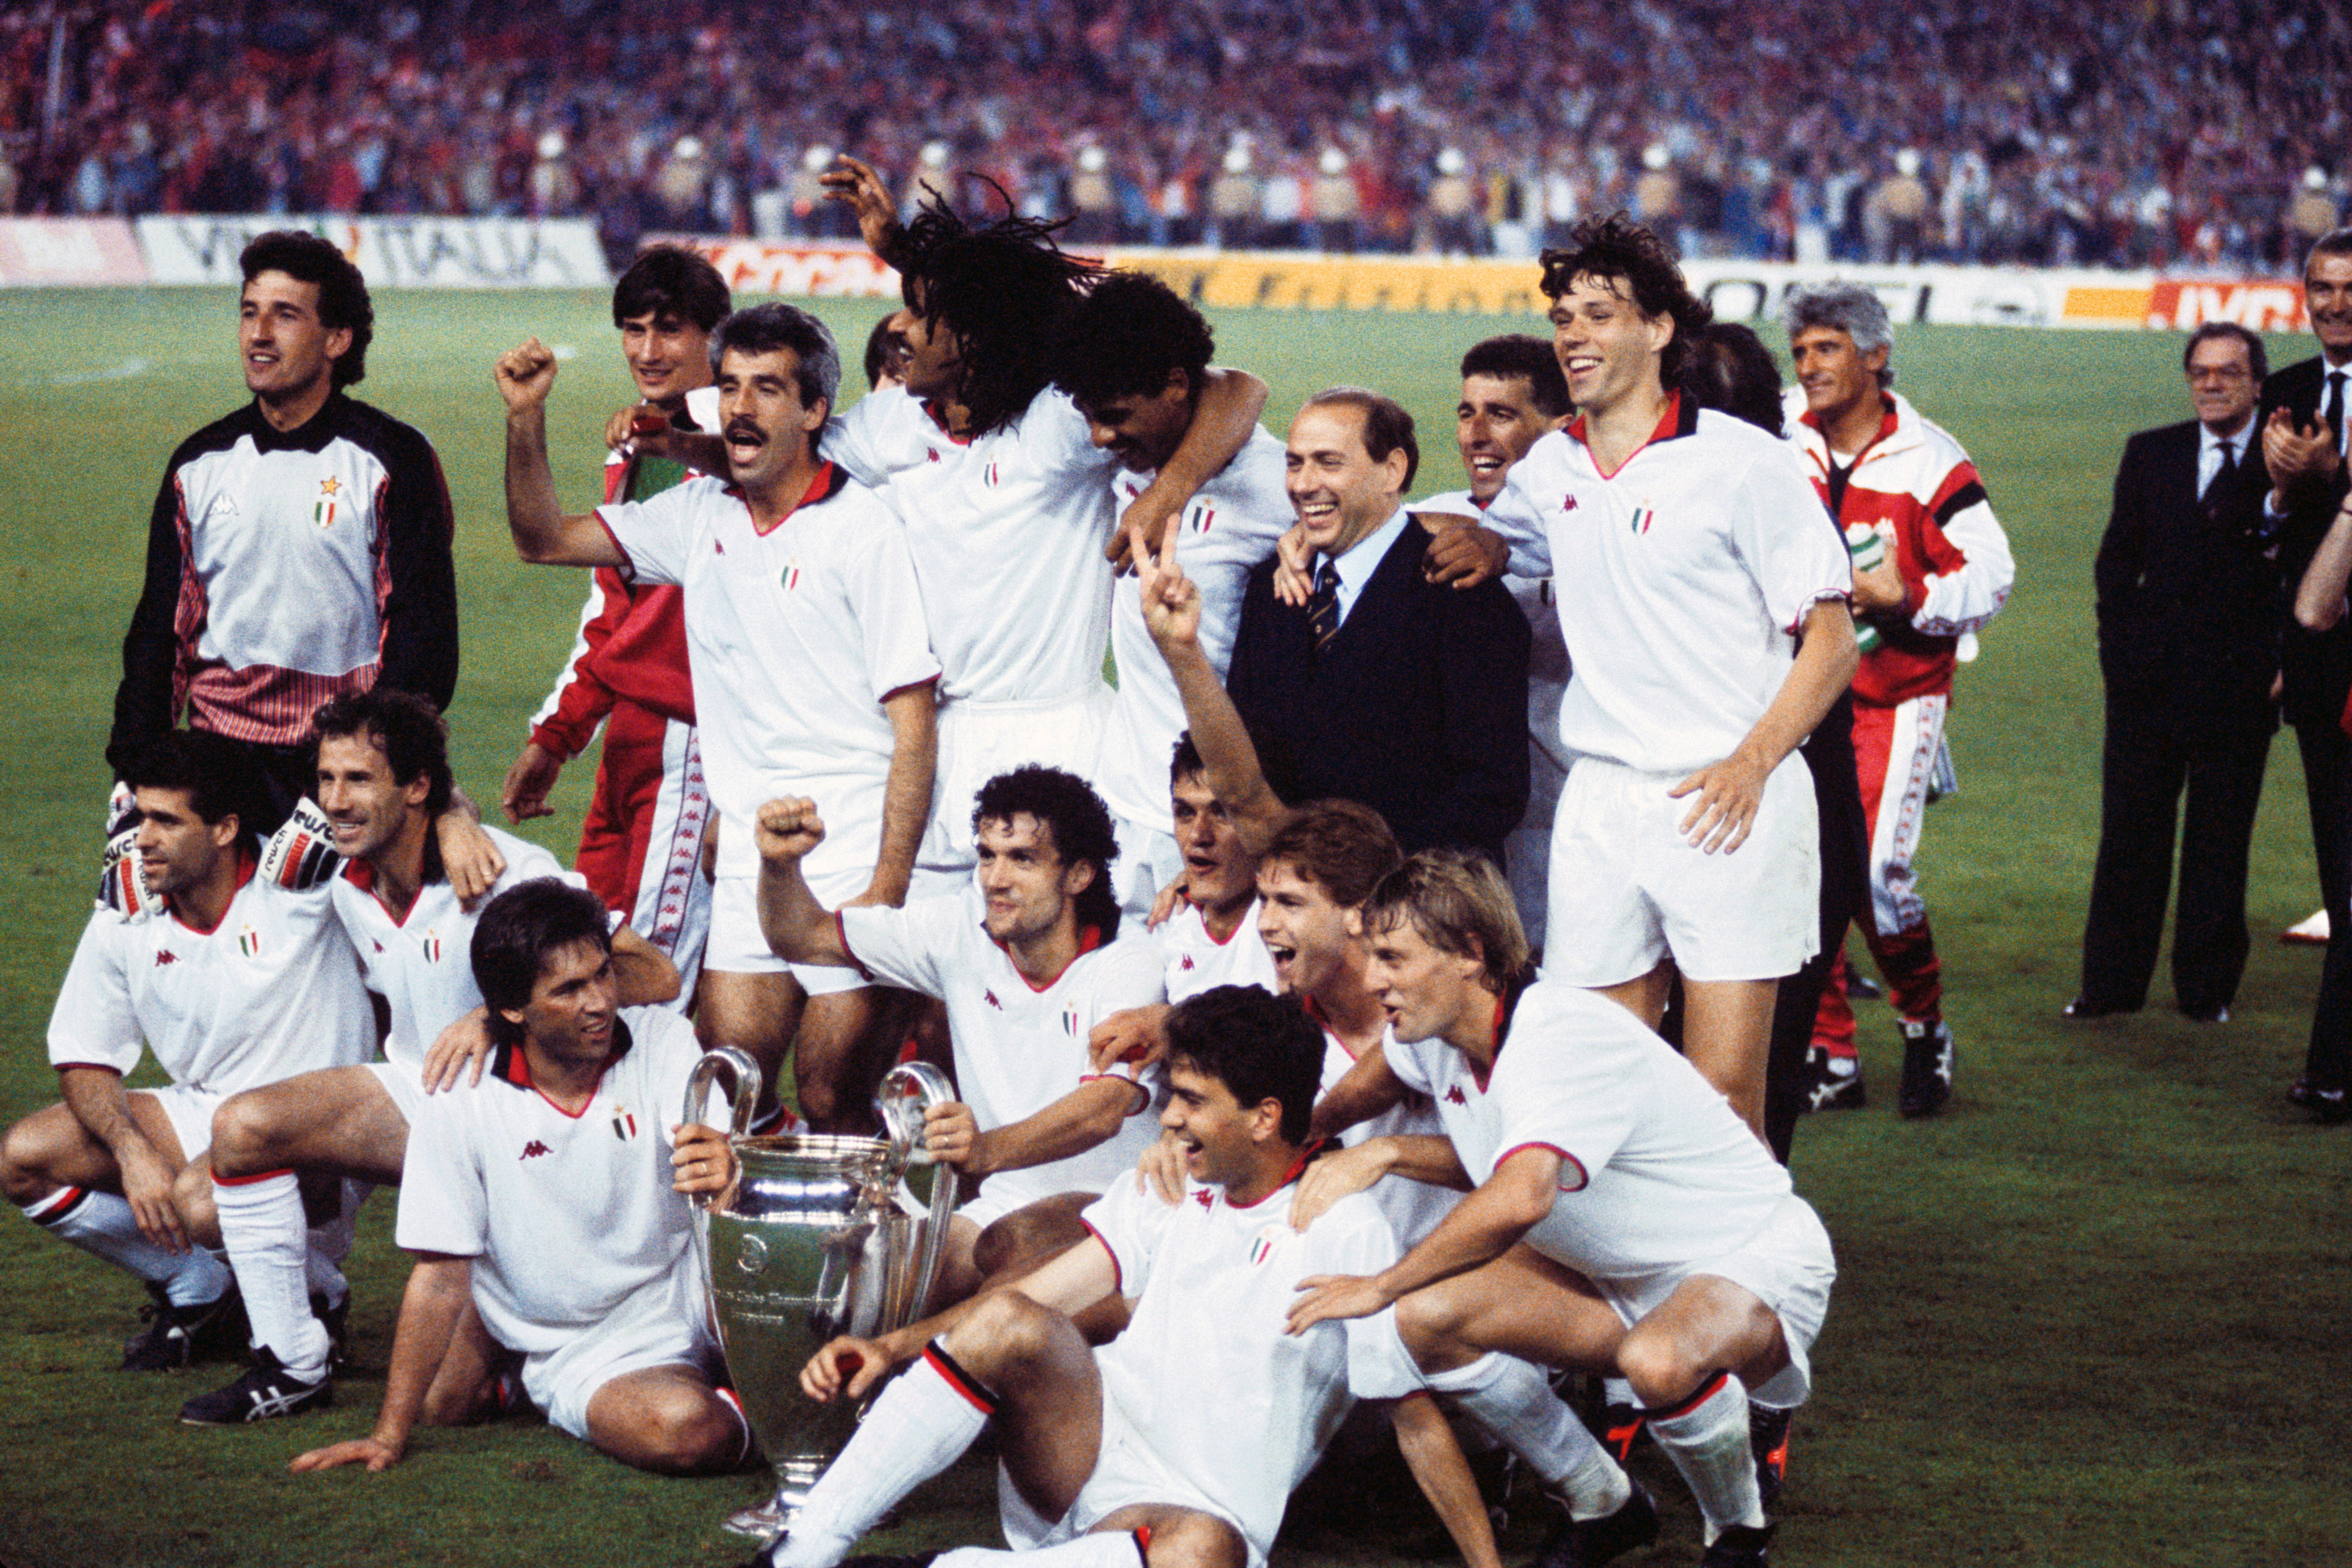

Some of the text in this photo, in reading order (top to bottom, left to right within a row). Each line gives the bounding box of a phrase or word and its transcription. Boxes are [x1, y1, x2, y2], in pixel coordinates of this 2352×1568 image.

[2148, 288, 2295, 330] JVC
[293, 809, 335, 844] eusc
[265, 830, 288, 872] reusch
